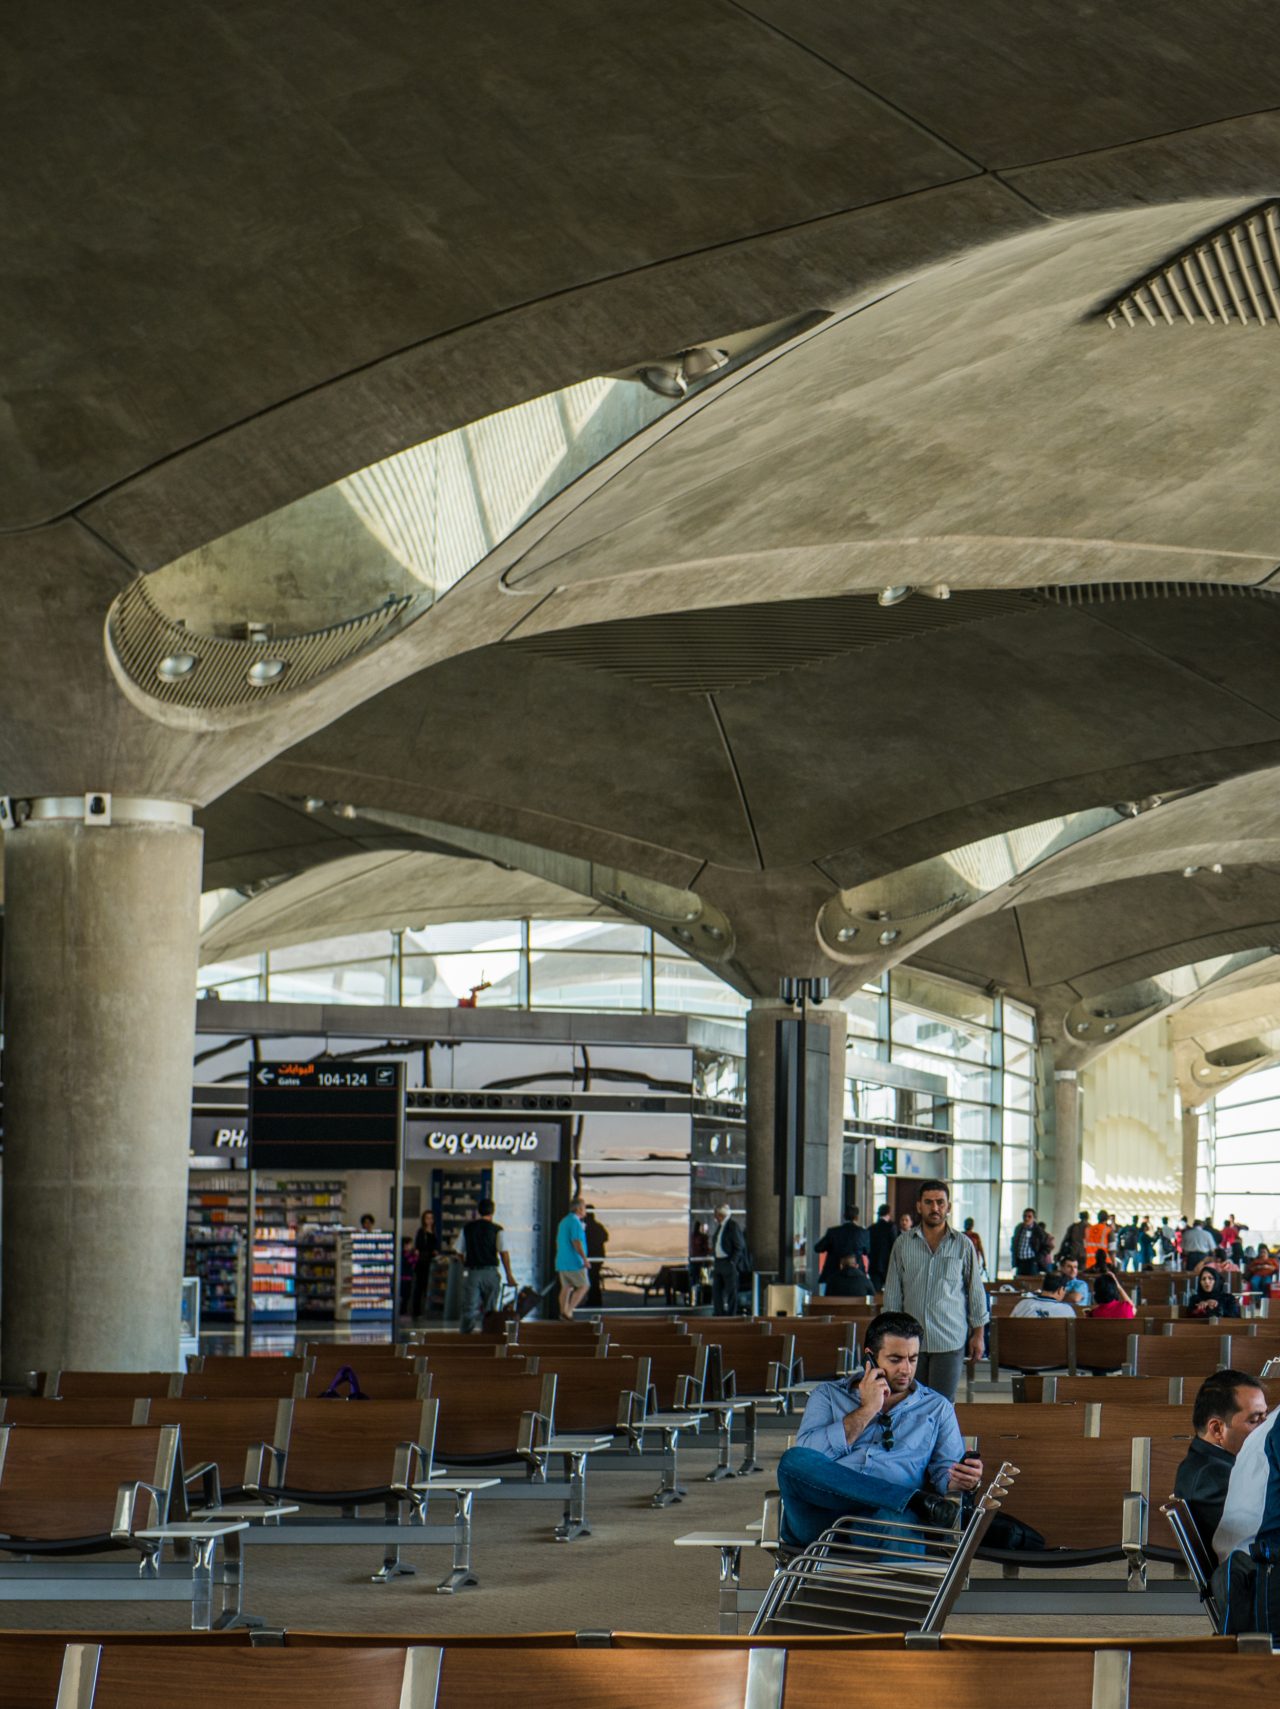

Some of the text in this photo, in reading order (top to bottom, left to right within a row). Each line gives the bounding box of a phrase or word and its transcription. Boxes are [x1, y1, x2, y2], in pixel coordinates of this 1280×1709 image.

[278, 1063, 315, 1075] البوابات
[277, 1073, 368, 1086] Gates 104-124
